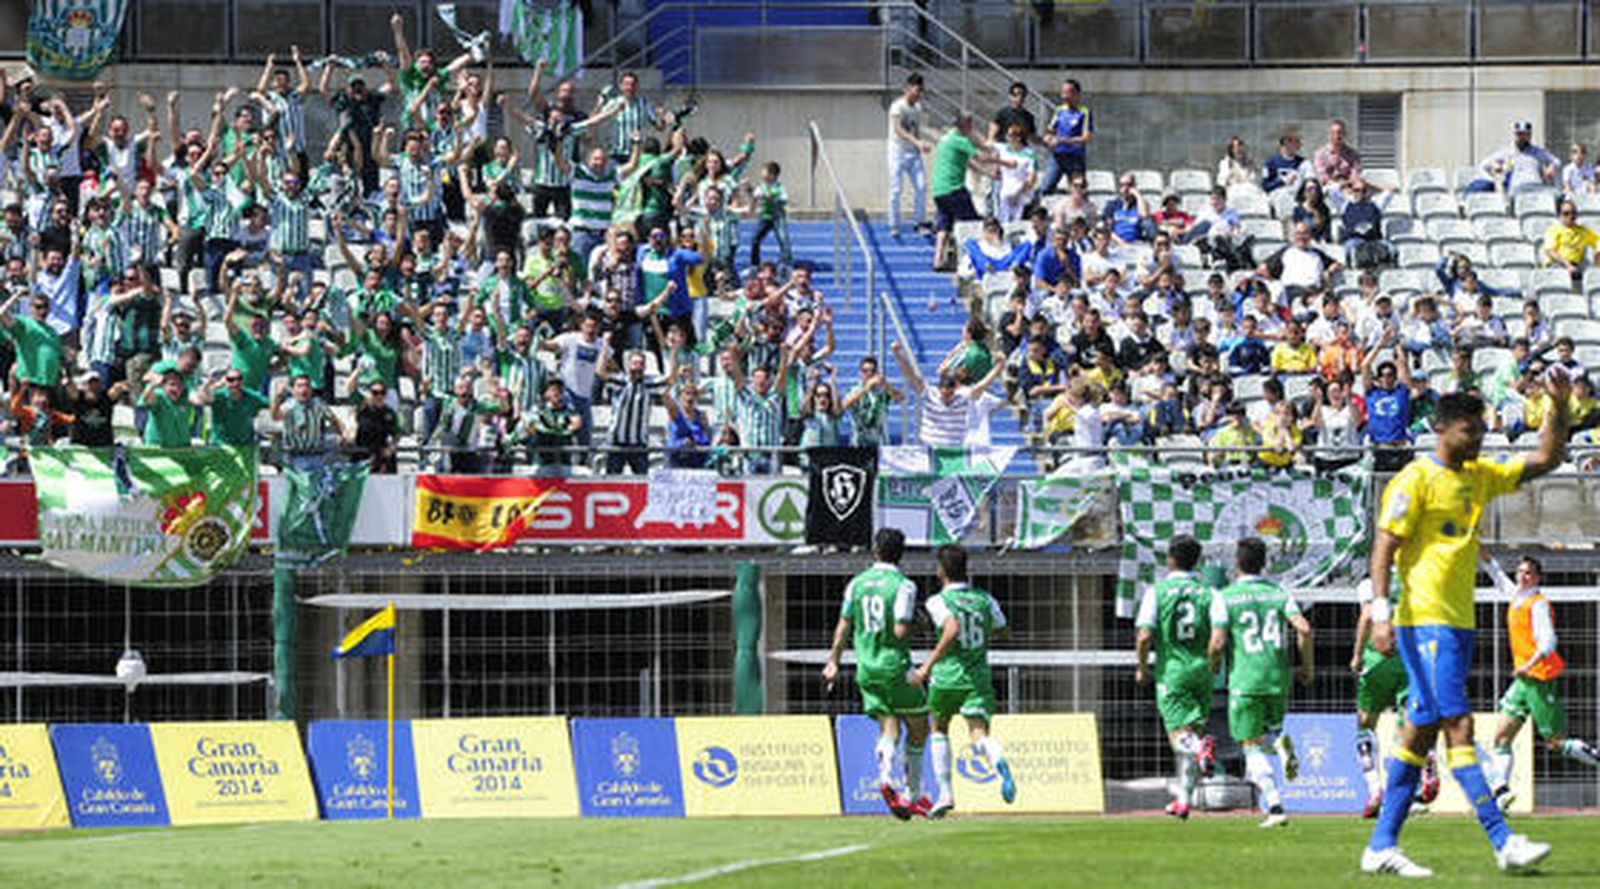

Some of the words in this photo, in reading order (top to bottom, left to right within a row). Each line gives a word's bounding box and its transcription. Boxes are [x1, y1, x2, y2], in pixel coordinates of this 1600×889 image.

[861, 595, 885, 632] 19
[1176, 600, 1196, 640] 2
[958, 611, 984, 649] 16
[1239, 609, 1281, 653] 24
[197, 736, 257, 758] Gran
[458, 734, 521, 754] Gran
[741, 742, 824, 755] INSTITUTO
[187, 754, 279, 777] Canaria
[447, 750, 543, 774] Canaria
[215, 778, 263, 797] 2014
[472, 774, 522, 793] 2014
[79, 801, 110, 815] Gran
[110, 801, 155, 815] Canaria
[327, 798, 357, 810] Gran
[591, 794, 622, 807] Gran
[624, 793, 671, 807] Canaria
